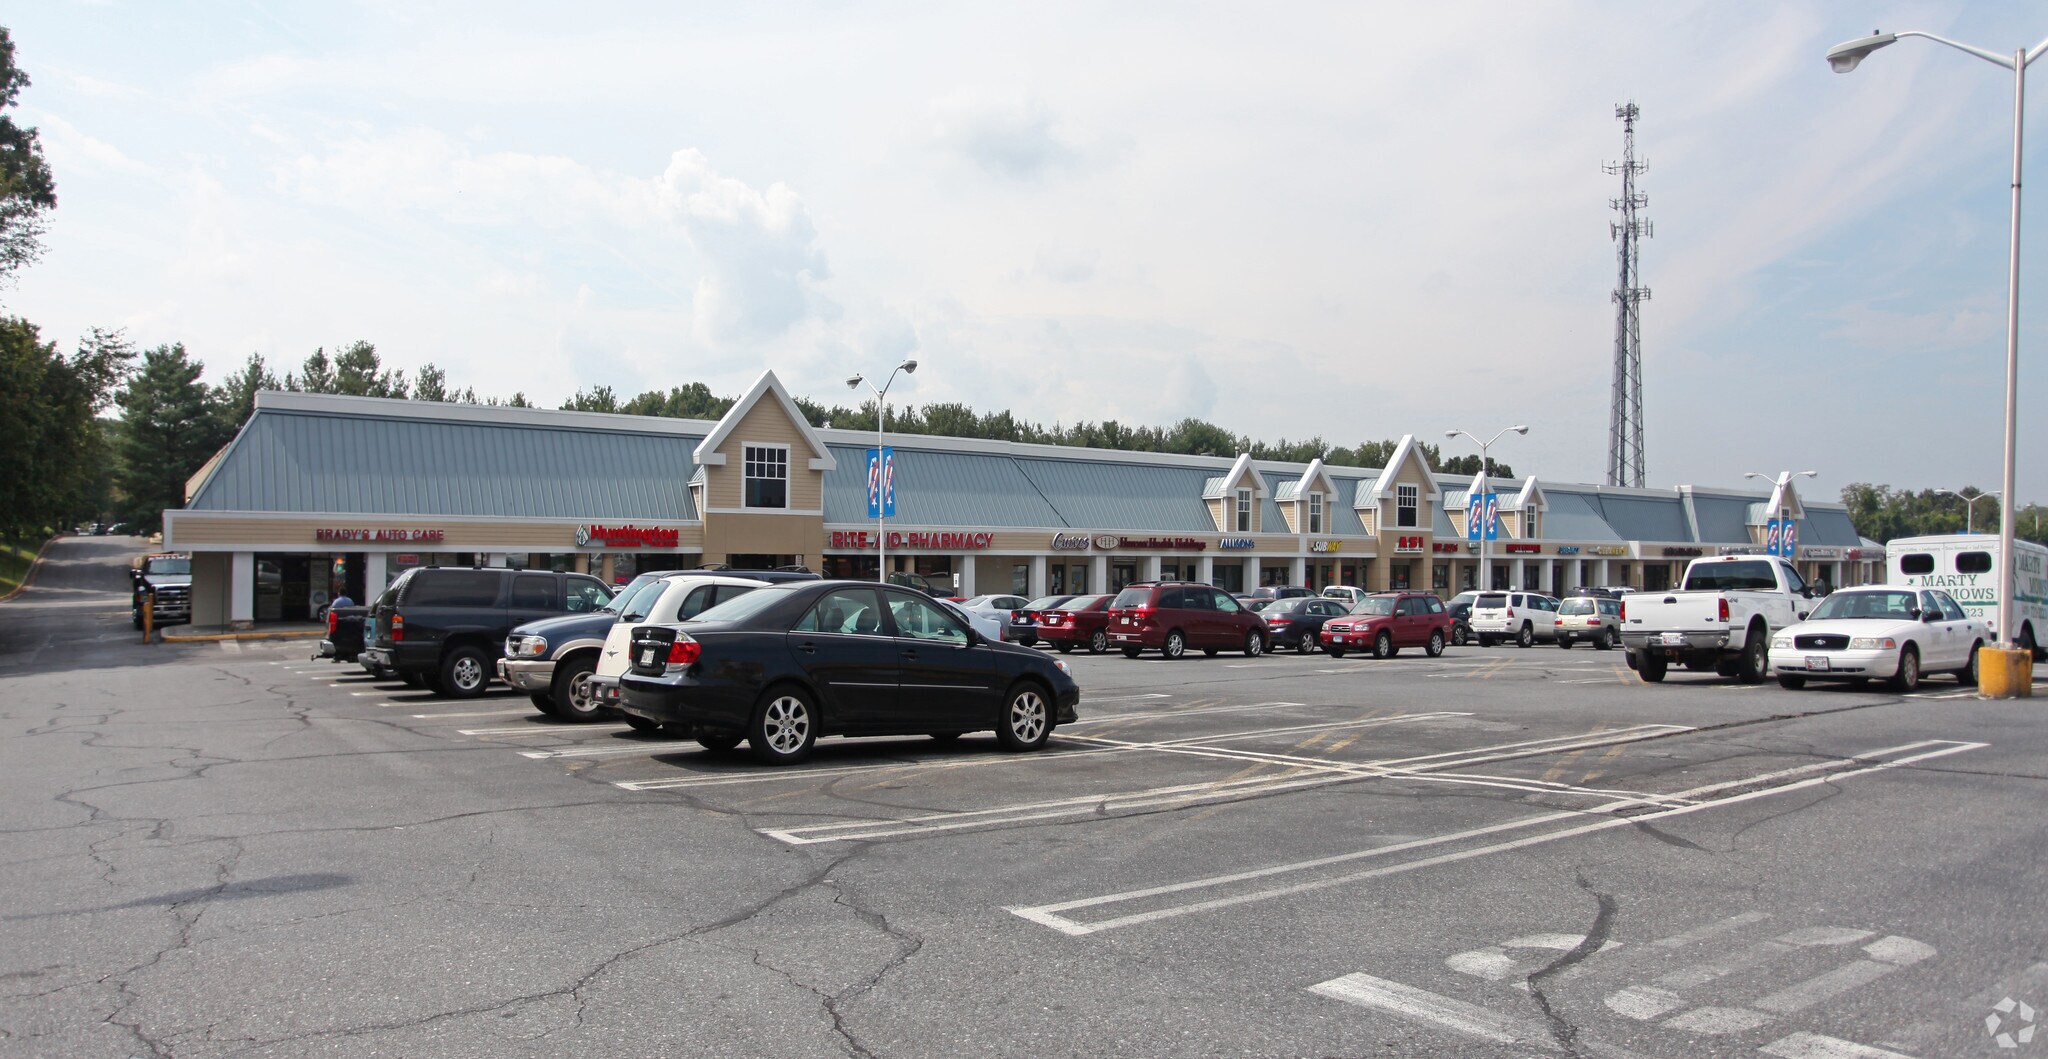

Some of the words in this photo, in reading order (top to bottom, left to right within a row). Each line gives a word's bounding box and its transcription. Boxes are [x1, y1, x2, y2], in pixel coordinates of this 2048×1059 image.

[316, 529, 370, 541] BRADY'S
[375, 529, 408, 541] AUTO
[412, 529, 444, 541] CARE
[589, 524, 679, 545] Huntington
[831, 531, 868, 549] RITE
[907, 531, 994, 550] PHARMACY
[1312, 540, 1344, 552] SUBWAY
[1397, 536, 1424, 548] ASI
[1920, 574, 1978, 587] MARTY
[1945, 587, 1994, 600] MOWS
